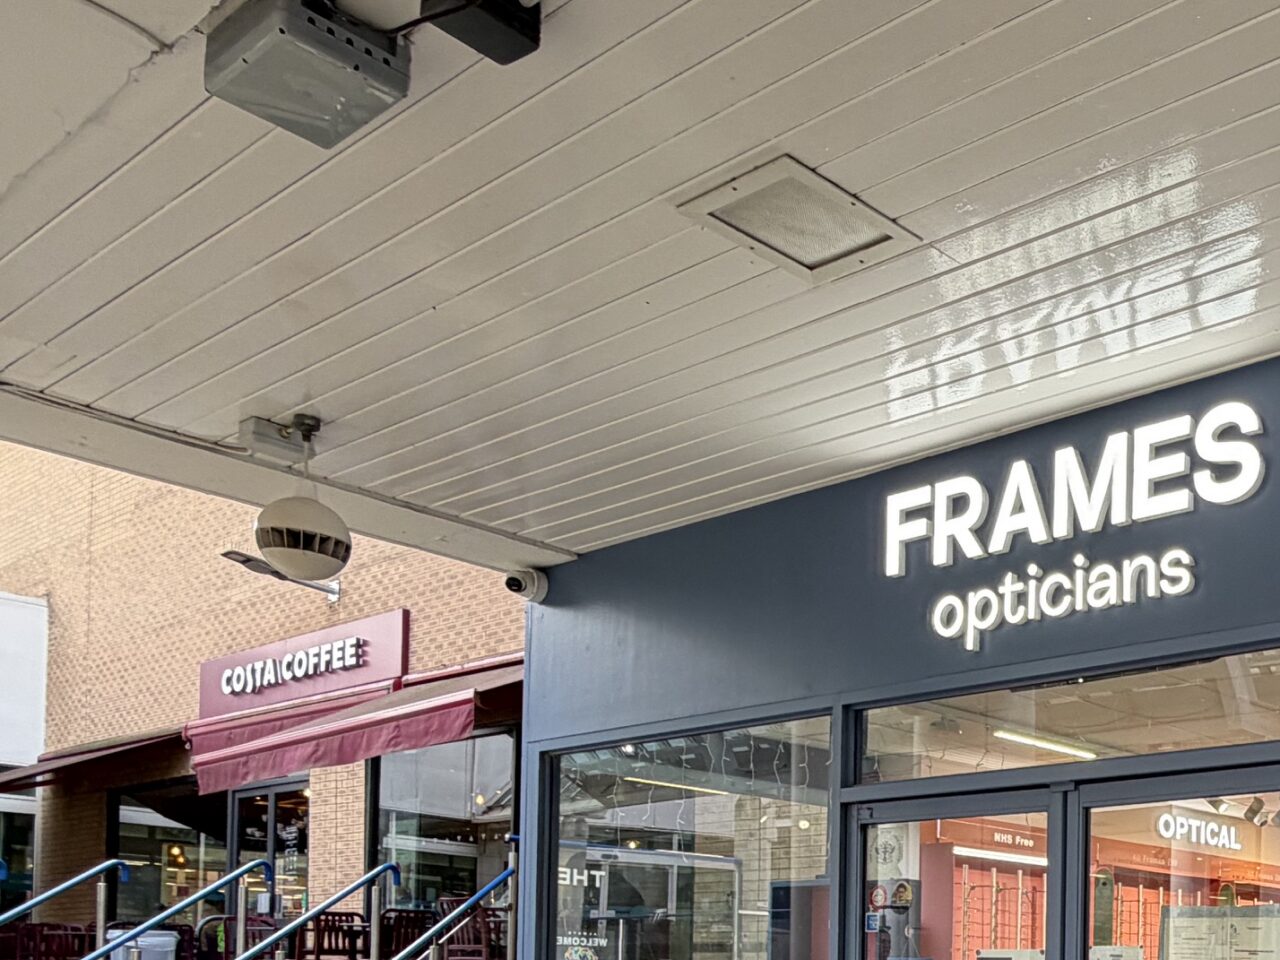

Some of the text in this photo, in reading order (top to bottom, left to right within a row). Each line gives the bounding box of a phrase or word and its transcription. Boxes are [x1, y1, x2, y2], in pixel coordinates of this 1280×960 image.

[885, 400, 1266, 578] FRAMES
[931, 548, 1196, 652] opticians
[221, 637, 362, 695] COSTA COFFEE
[994, 831, 1035, 848] NHS Free
[1158, 812, 1242, 851] OPTICAL
